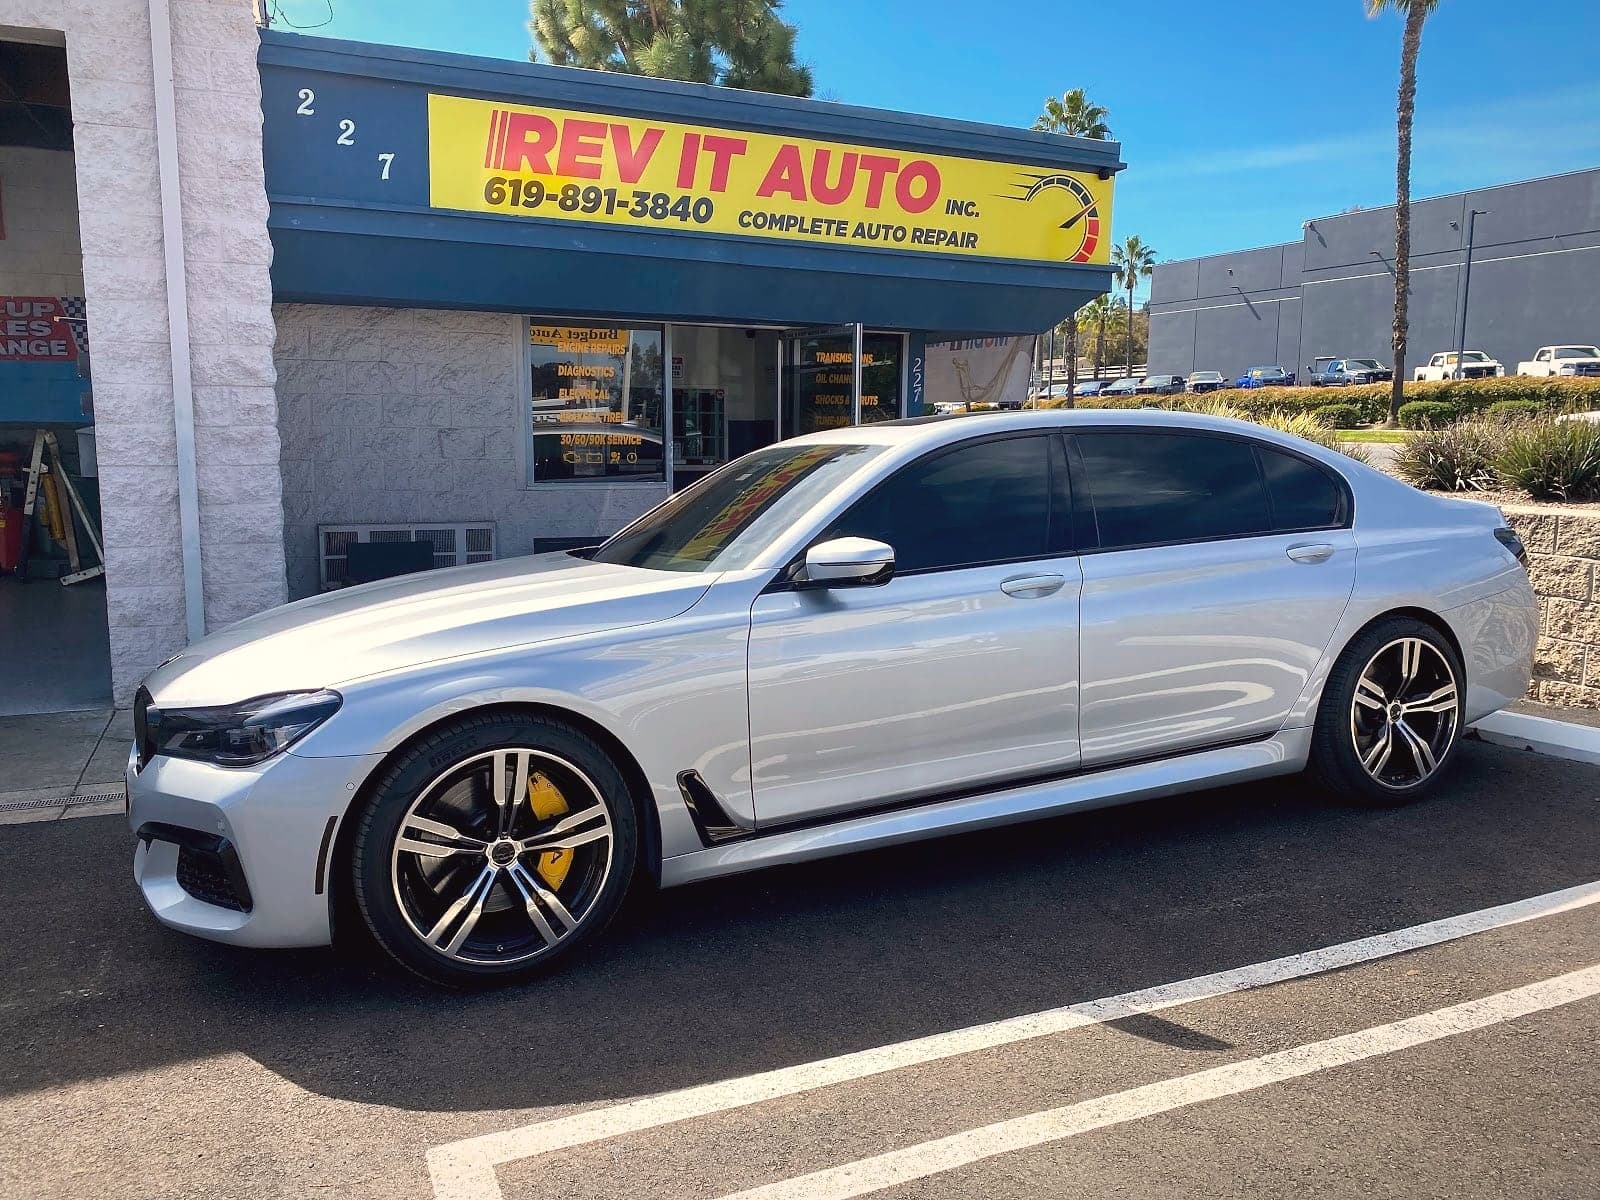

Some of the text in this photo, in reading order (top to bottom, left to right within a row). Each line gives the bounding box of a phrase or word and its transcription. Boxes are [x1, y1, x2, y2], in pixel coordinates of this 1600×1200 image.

[502, 112, 980, 218] REV IT AUTO INC.
[484, 176, 714, 224] 619-891-3840
[738, 210, 979, 249] COMPLETE AUTO REPAIR
[557, 342, 626, 355] ENGINE REPAIRS
[557, 365, 616, 378] DIAGNOSTICS
[560, 434, 642, 446] 30/60/90K SERVICE
